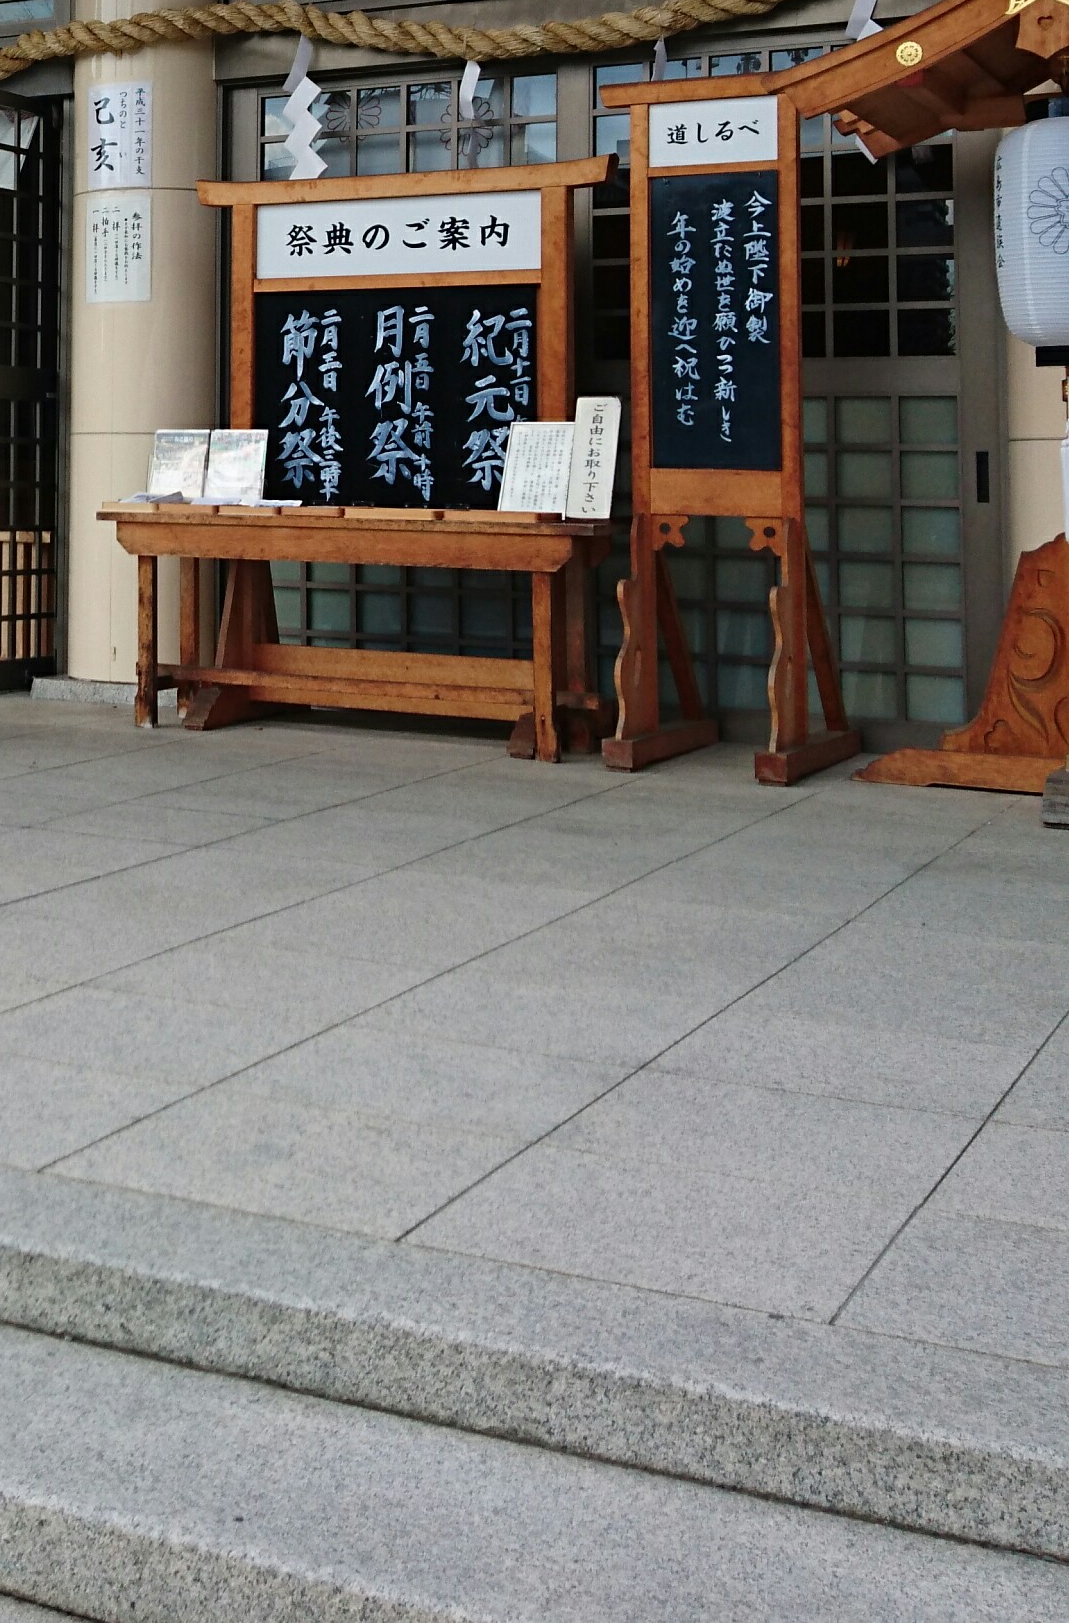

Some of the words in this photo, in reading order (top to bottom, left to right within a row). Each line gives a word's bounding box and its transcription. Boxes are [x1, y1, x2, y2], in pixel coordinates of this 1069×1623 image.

[134, 88, 146, 175] 平成三十一年の干支
[666, 120, 760, 145] 道しるべ
[285, 214, 510, 257] 祭典のご案内
[318, 308, 343, 392] 二月三日
[365, 305, 420, 485] 月例祭
[408, 306, 435, 391] 二月五日
[505, 307, 532, 406] 二月十一日
[275, 309, 324, 489] 節分祭
[460, 309, 514, 491] 紀元祭
[582, 403, 608, 514] ご自由にお取り下さい
